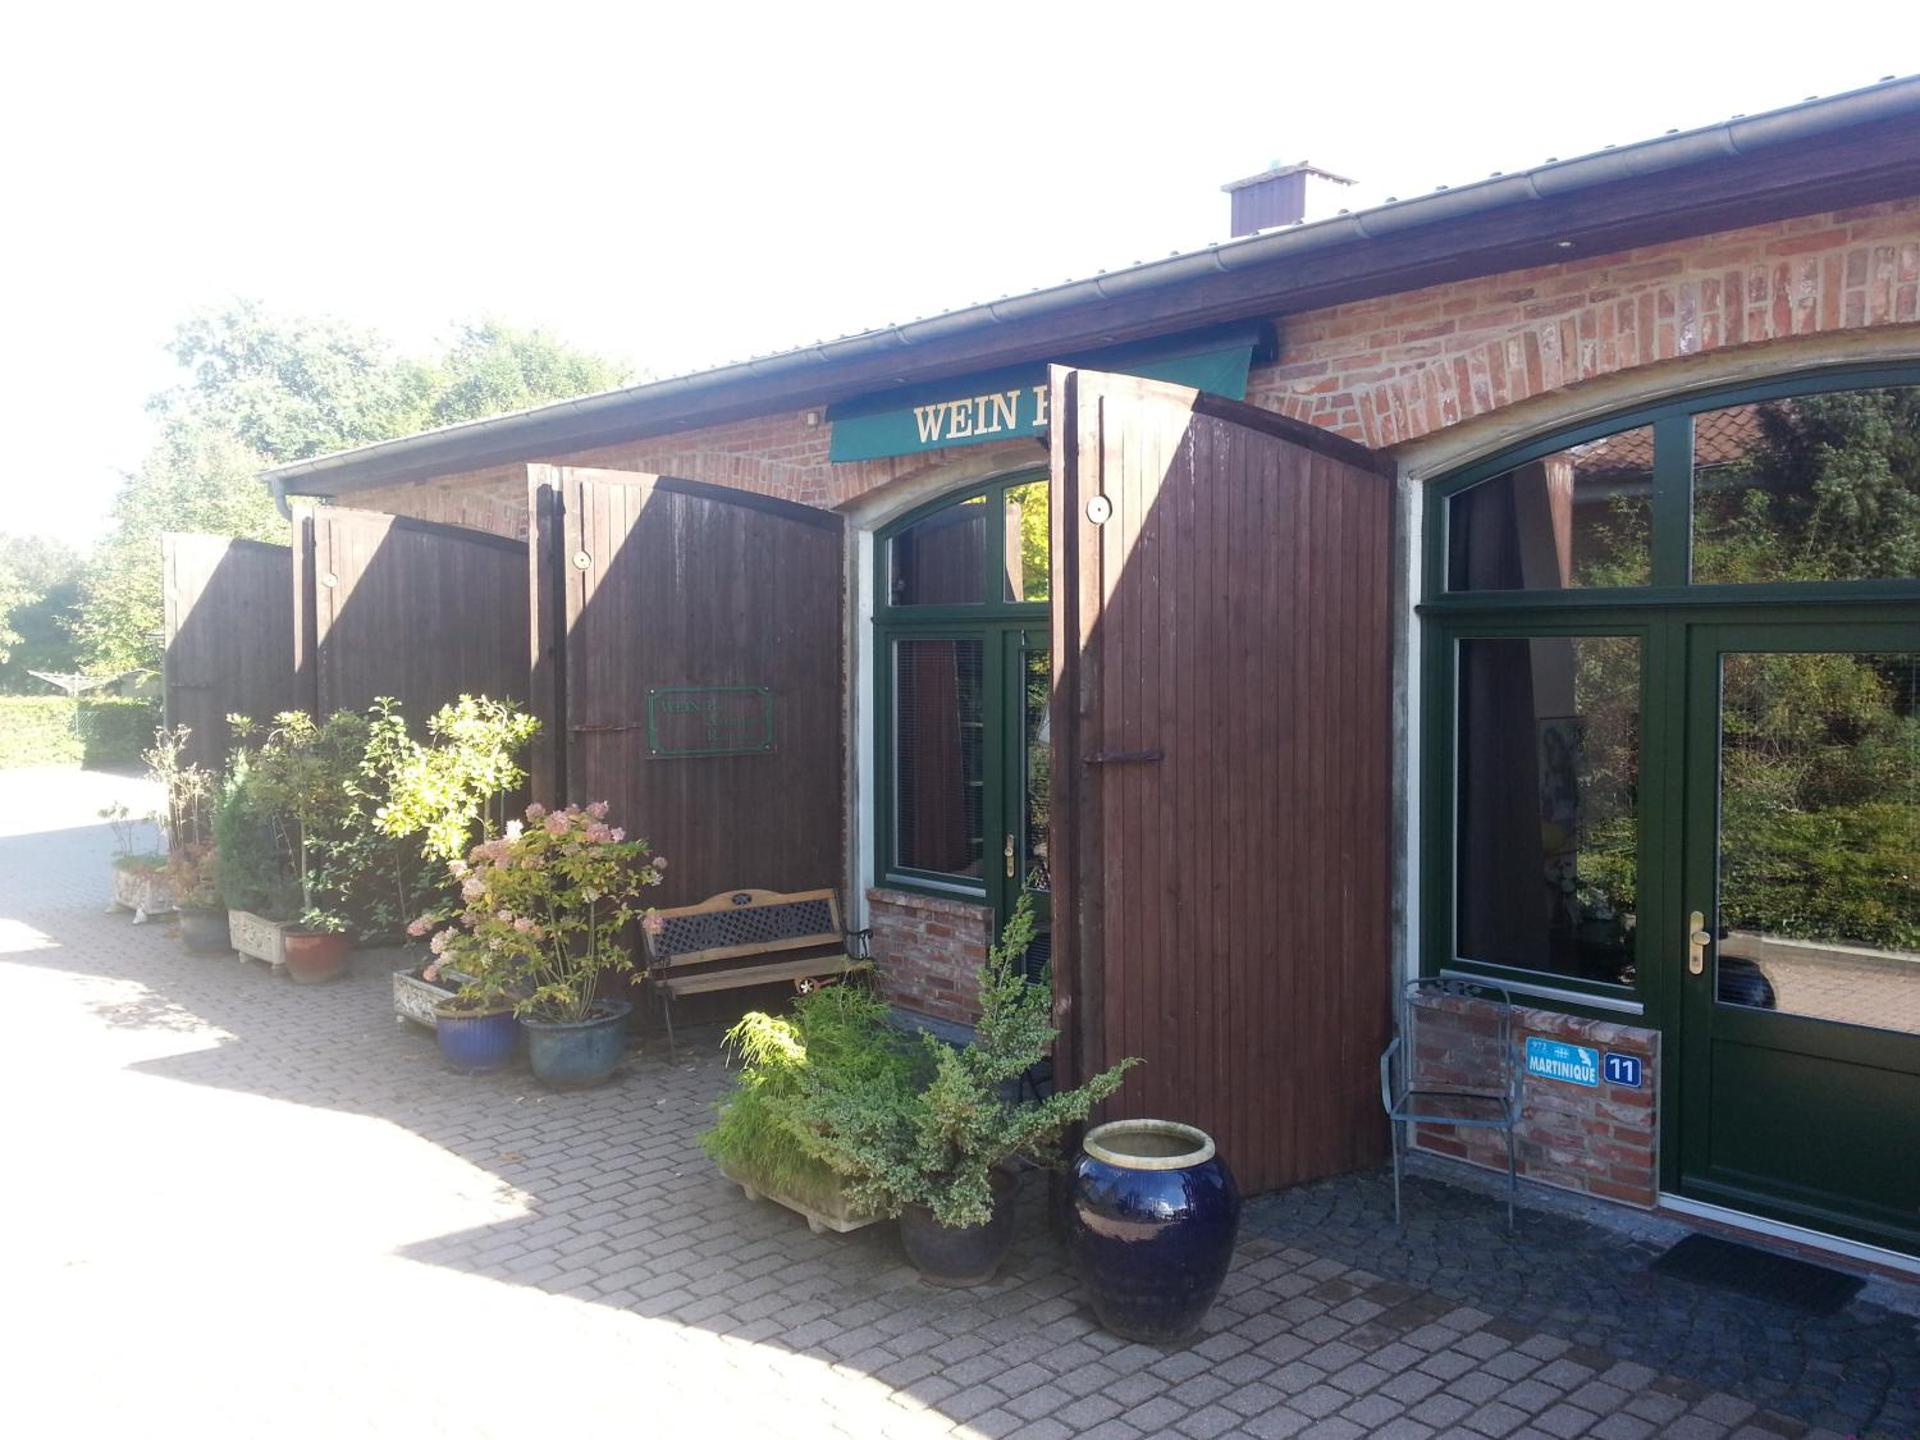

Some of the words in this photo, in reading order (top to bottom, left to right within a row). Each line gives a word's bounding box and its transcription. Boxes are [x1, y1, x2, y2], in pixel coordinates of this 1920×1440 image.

[913, 389, 1021, 443] WEIN
[1529, 1055, 1596, 1083] MARTINIQUE
[1610, 1058, 1633, 1082] 11
